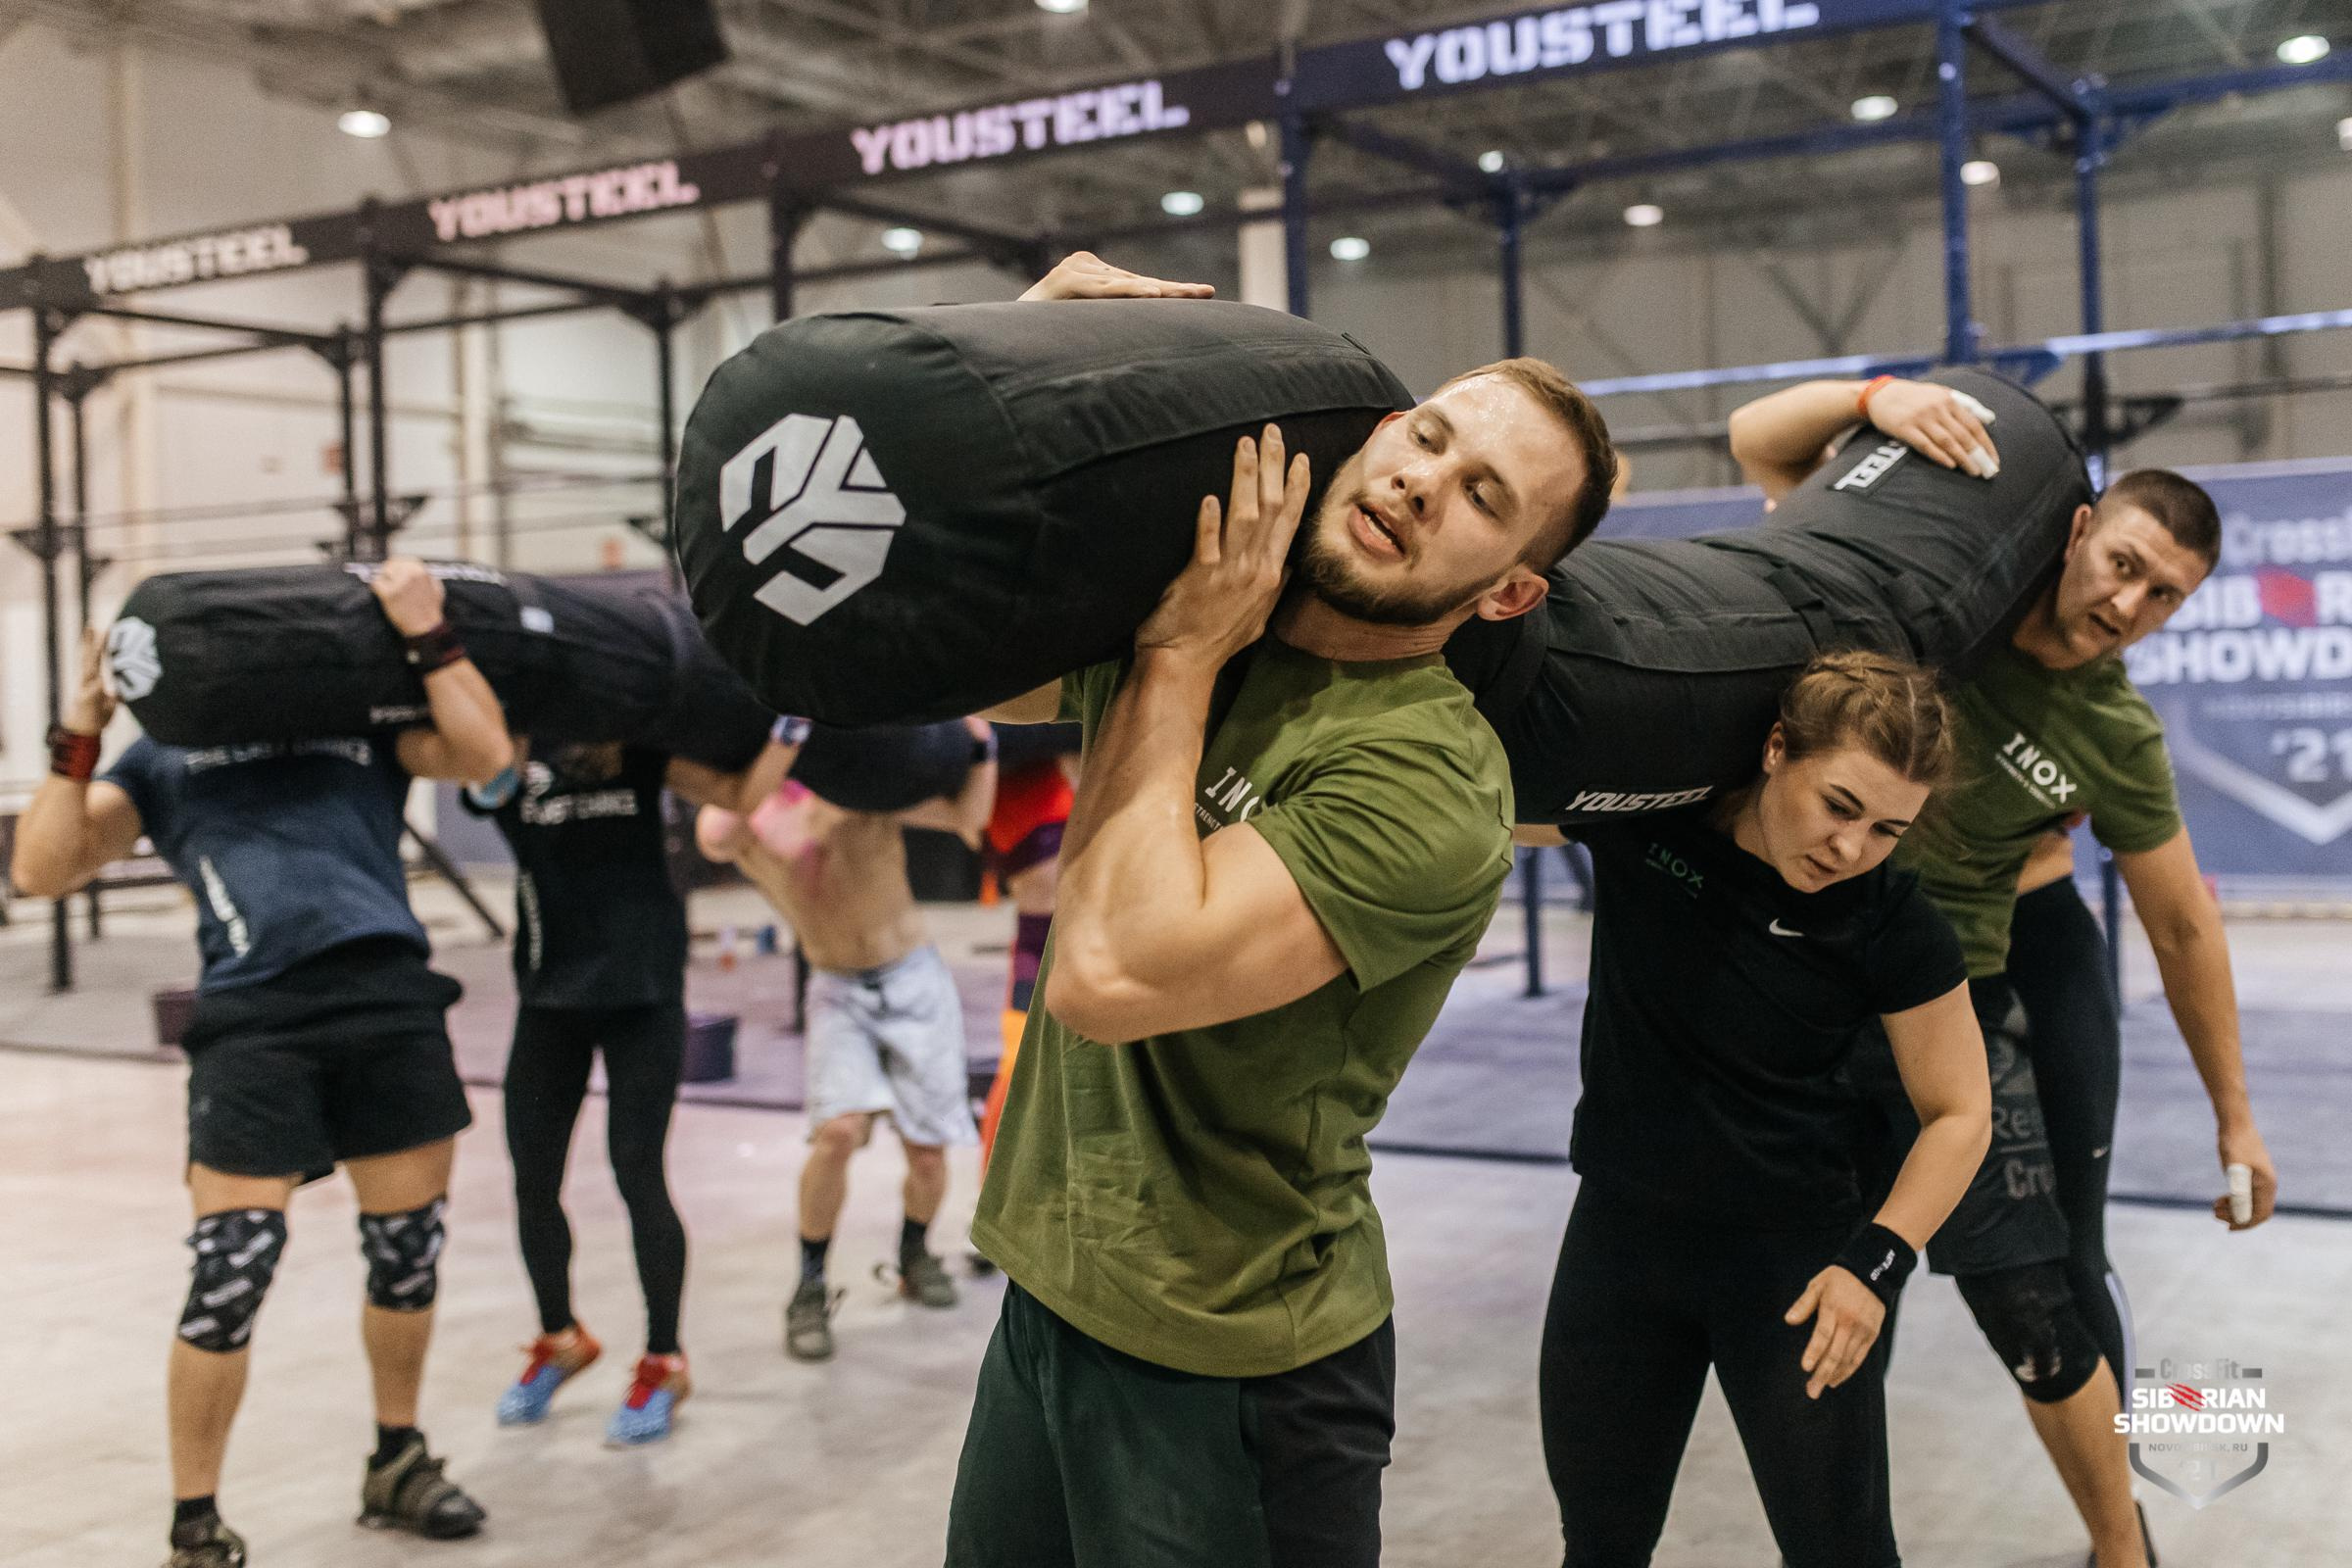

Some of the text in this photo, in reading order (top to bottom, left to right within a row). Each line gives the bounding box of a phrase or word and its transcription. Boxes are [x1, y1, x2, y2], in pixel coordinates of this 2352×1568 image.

[1384, 0, 1820, 89] YOUSTEEL
[850, 79, 1191, 174] YOUSTEEL
[427, 160, 701, 241] YOUSTEEL
[1834, 441, 1908, 490] TEEL
[1565, 785, 1714, 812] YOUSTEEL
[2002, 733, 2078, 804] INOX
[1647, 842, 1705, 889] INOX
